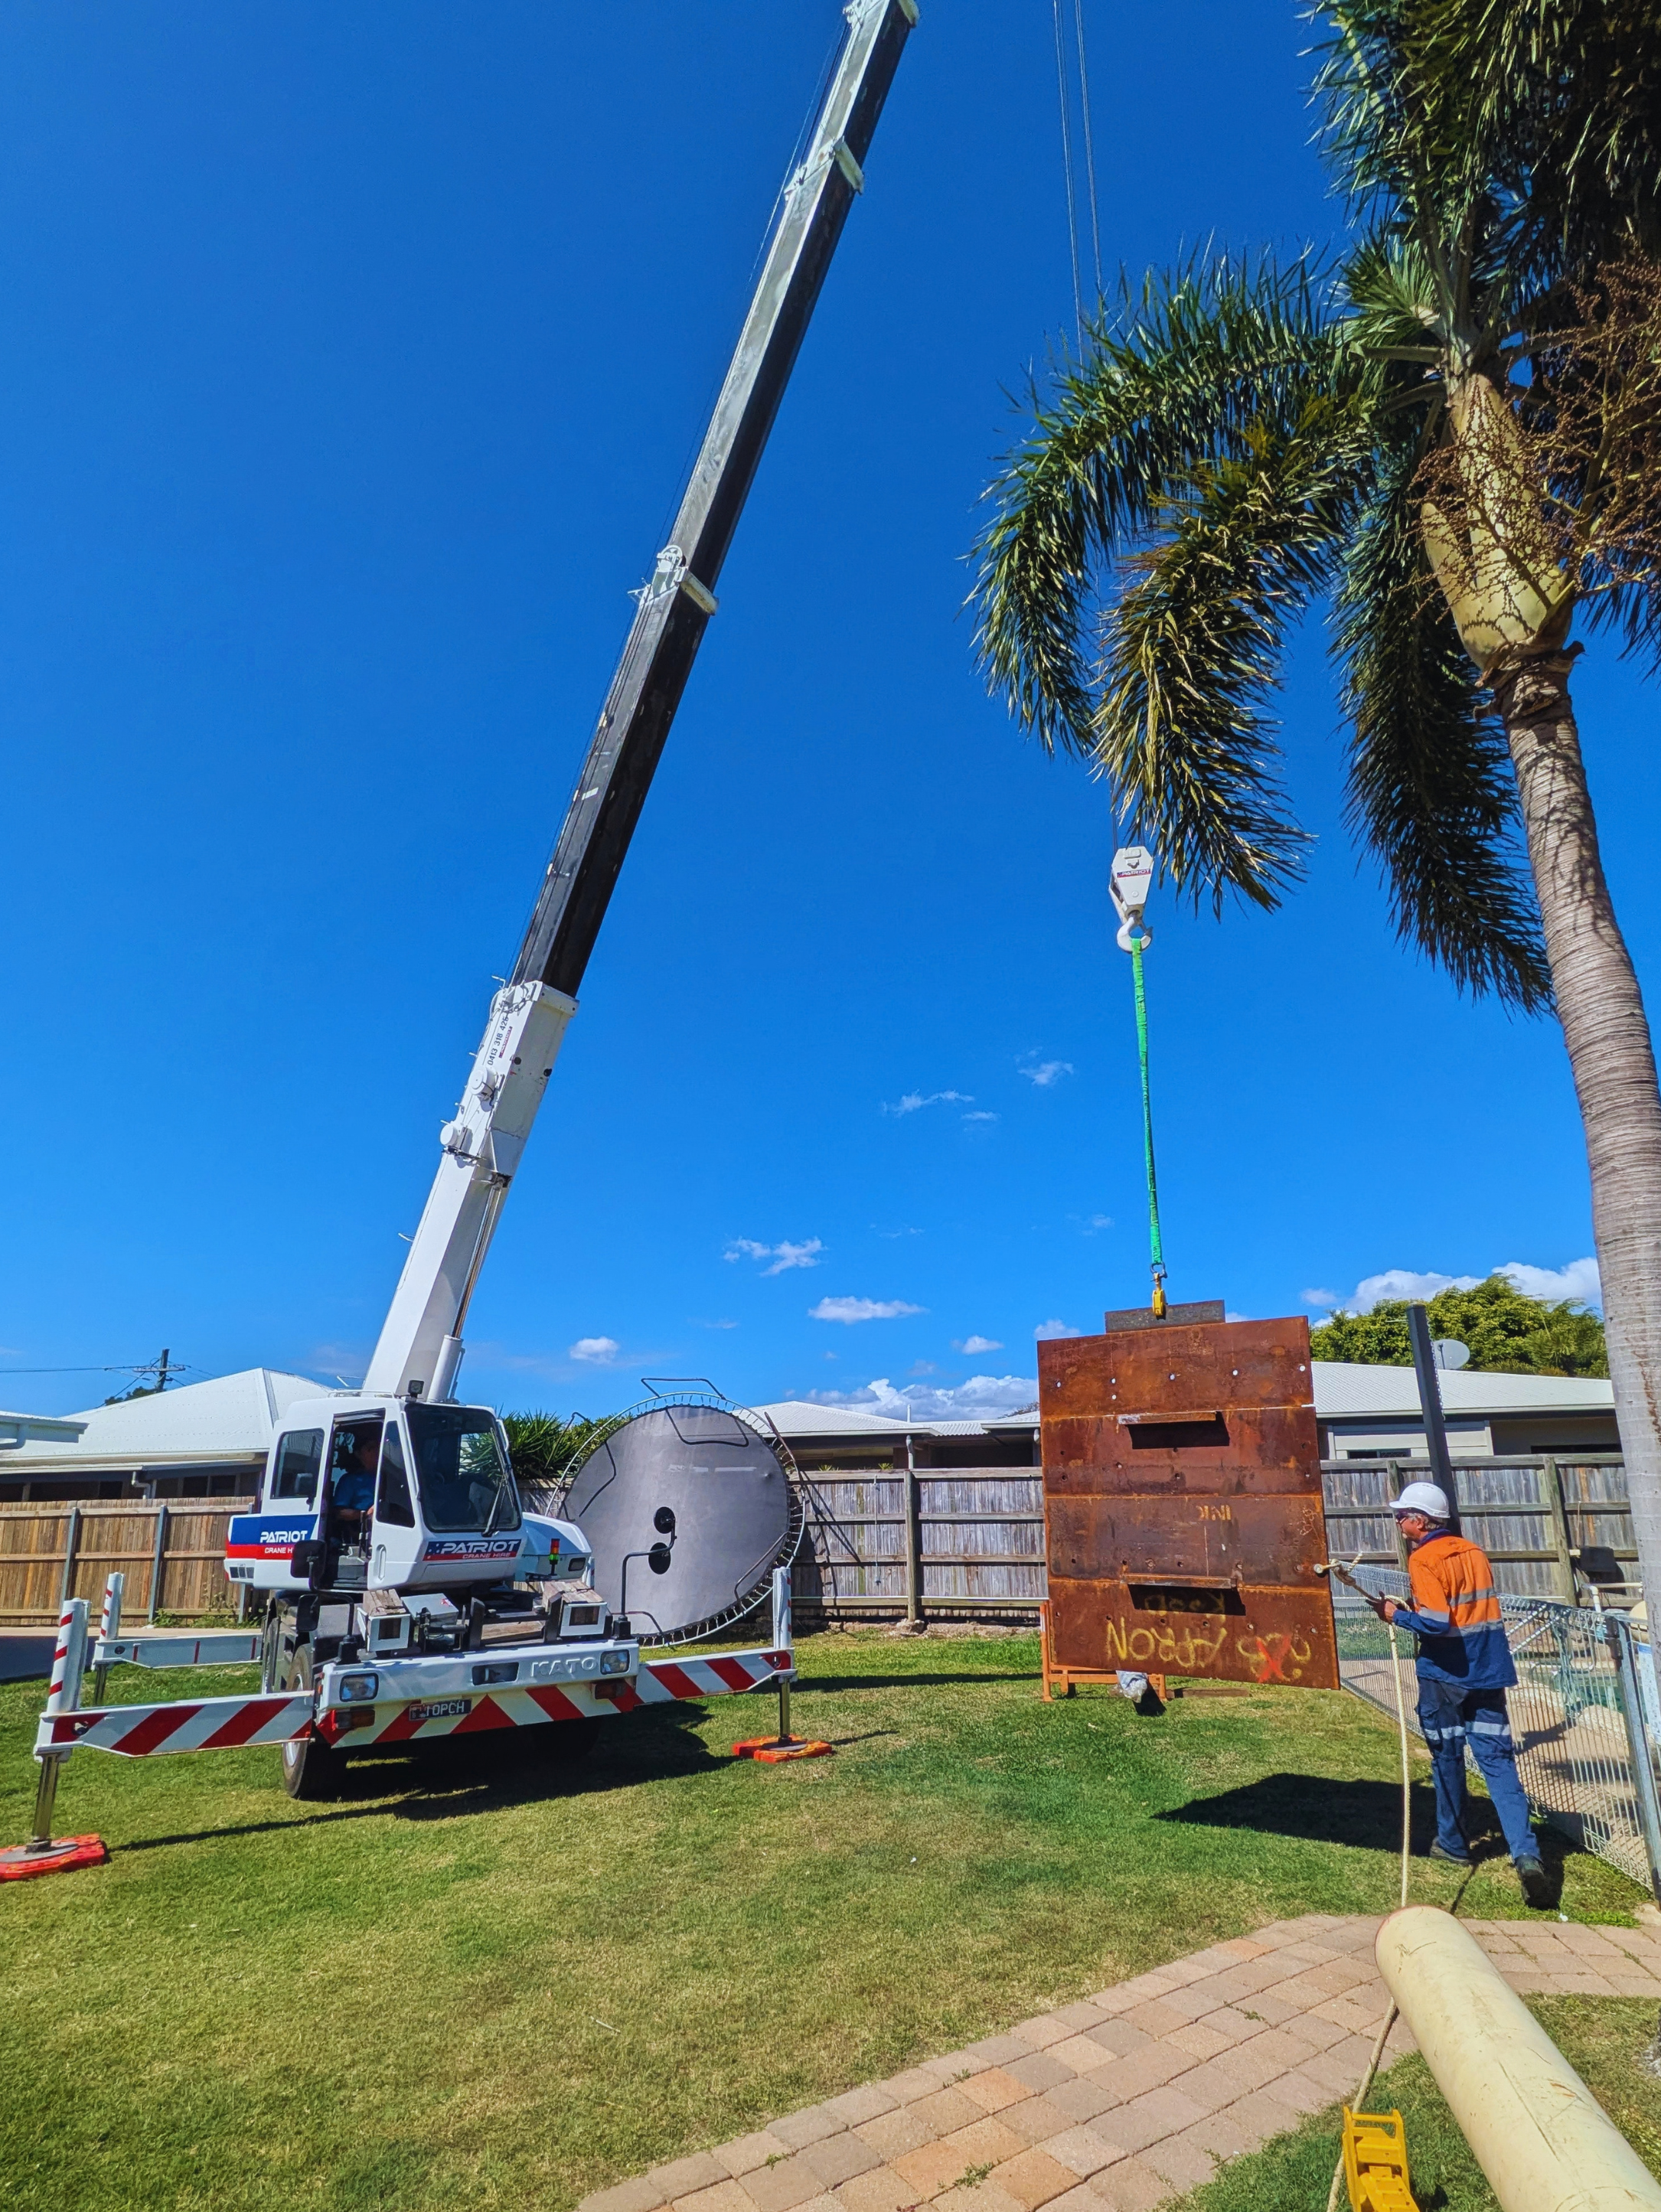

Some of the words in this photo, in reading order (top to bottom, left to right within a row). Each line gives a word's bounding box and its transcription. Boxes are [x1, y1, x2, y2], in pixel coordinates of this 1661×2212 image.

[488, 1048, 498, 1065] 0413
[494, 1033, 503, 1046] 318
[259, 1530, 308, 1543] PATRIOT
[440, 1541, 520, 1555] PATRIOT
[531, 1657, 597, 1677] KATO
